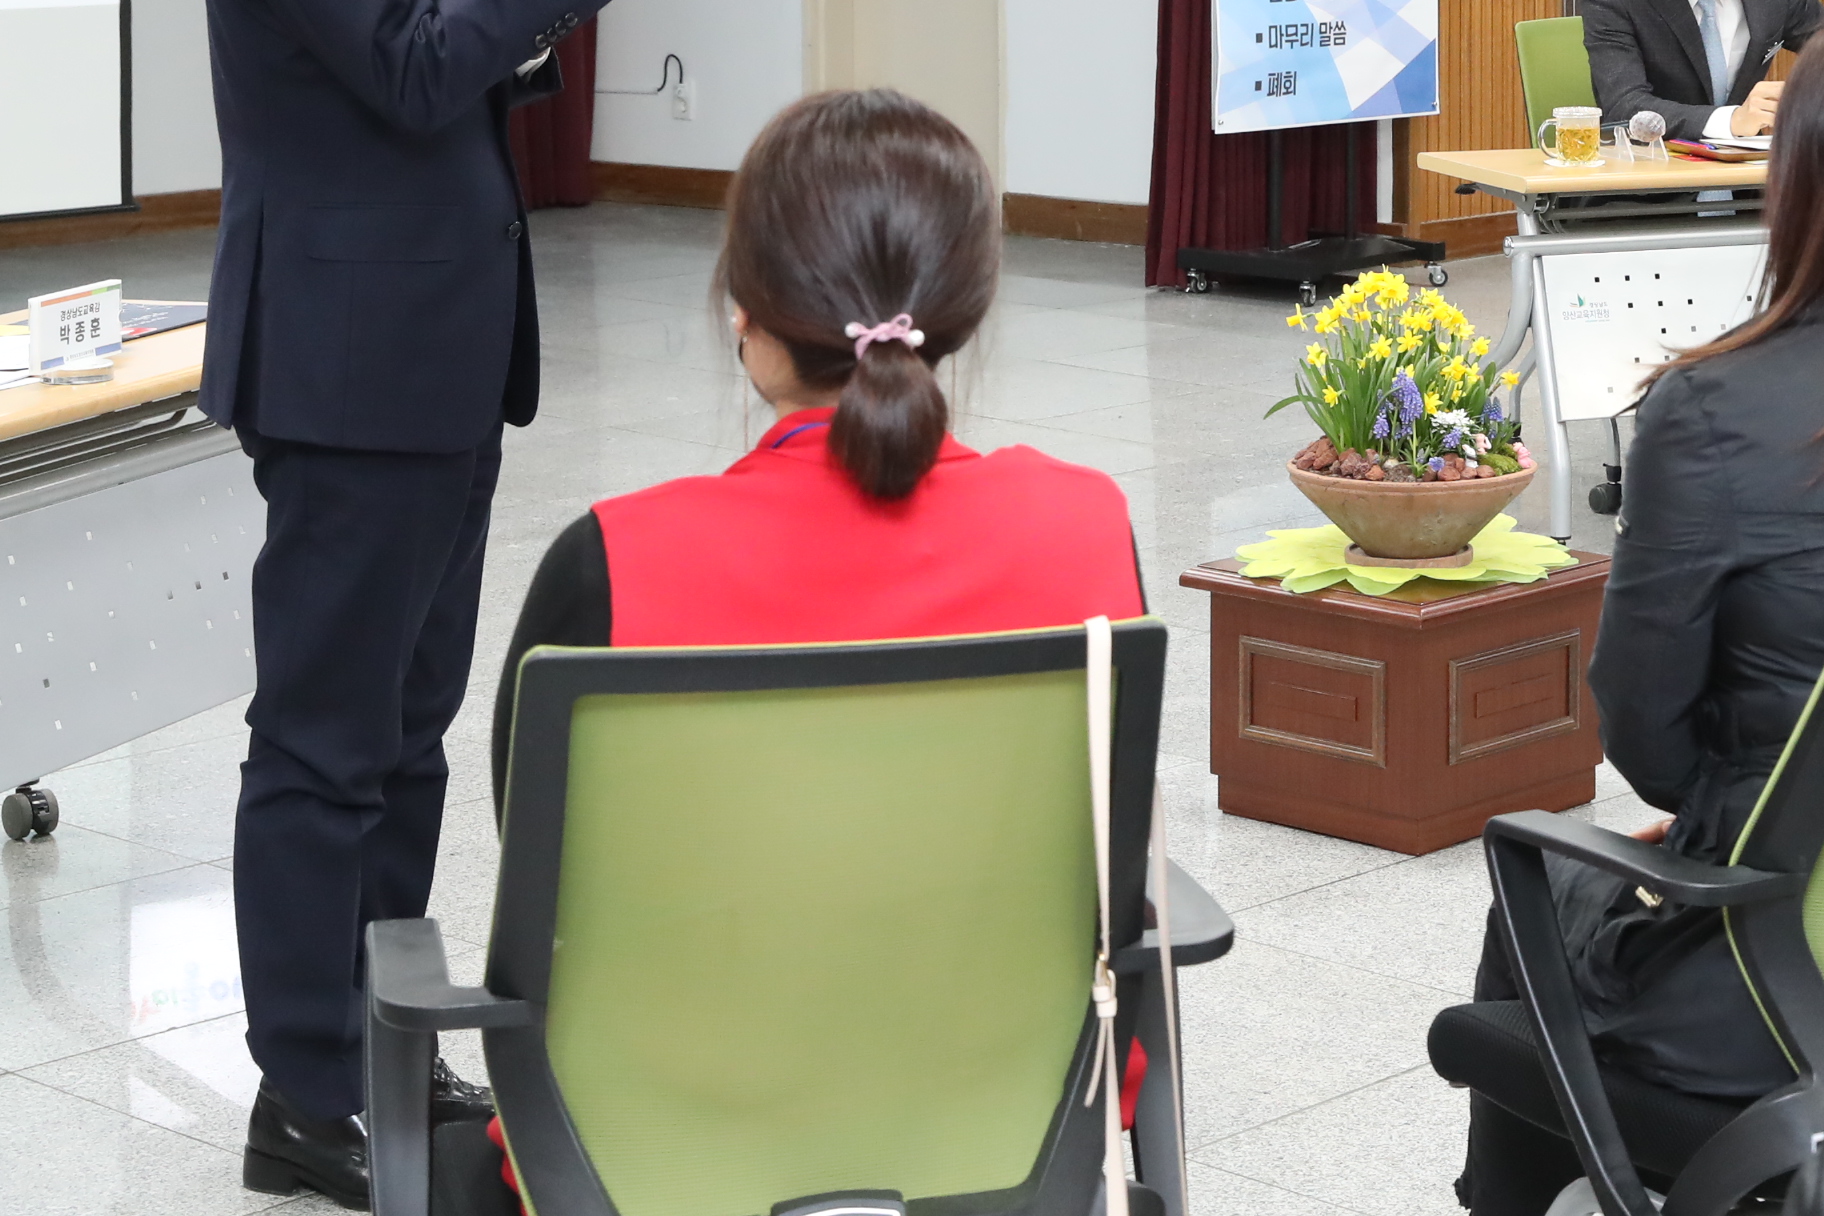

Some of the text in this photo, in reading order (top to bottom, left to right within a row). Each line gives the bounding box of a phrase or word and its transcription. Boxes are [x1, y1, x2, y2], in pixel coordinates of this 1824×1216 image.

[1268, 21, 1346, 49] 마무리 말씀
[1267, 72, 1297, 98] 폐회
[60, 302, 100, 321] 경상남도교육감
